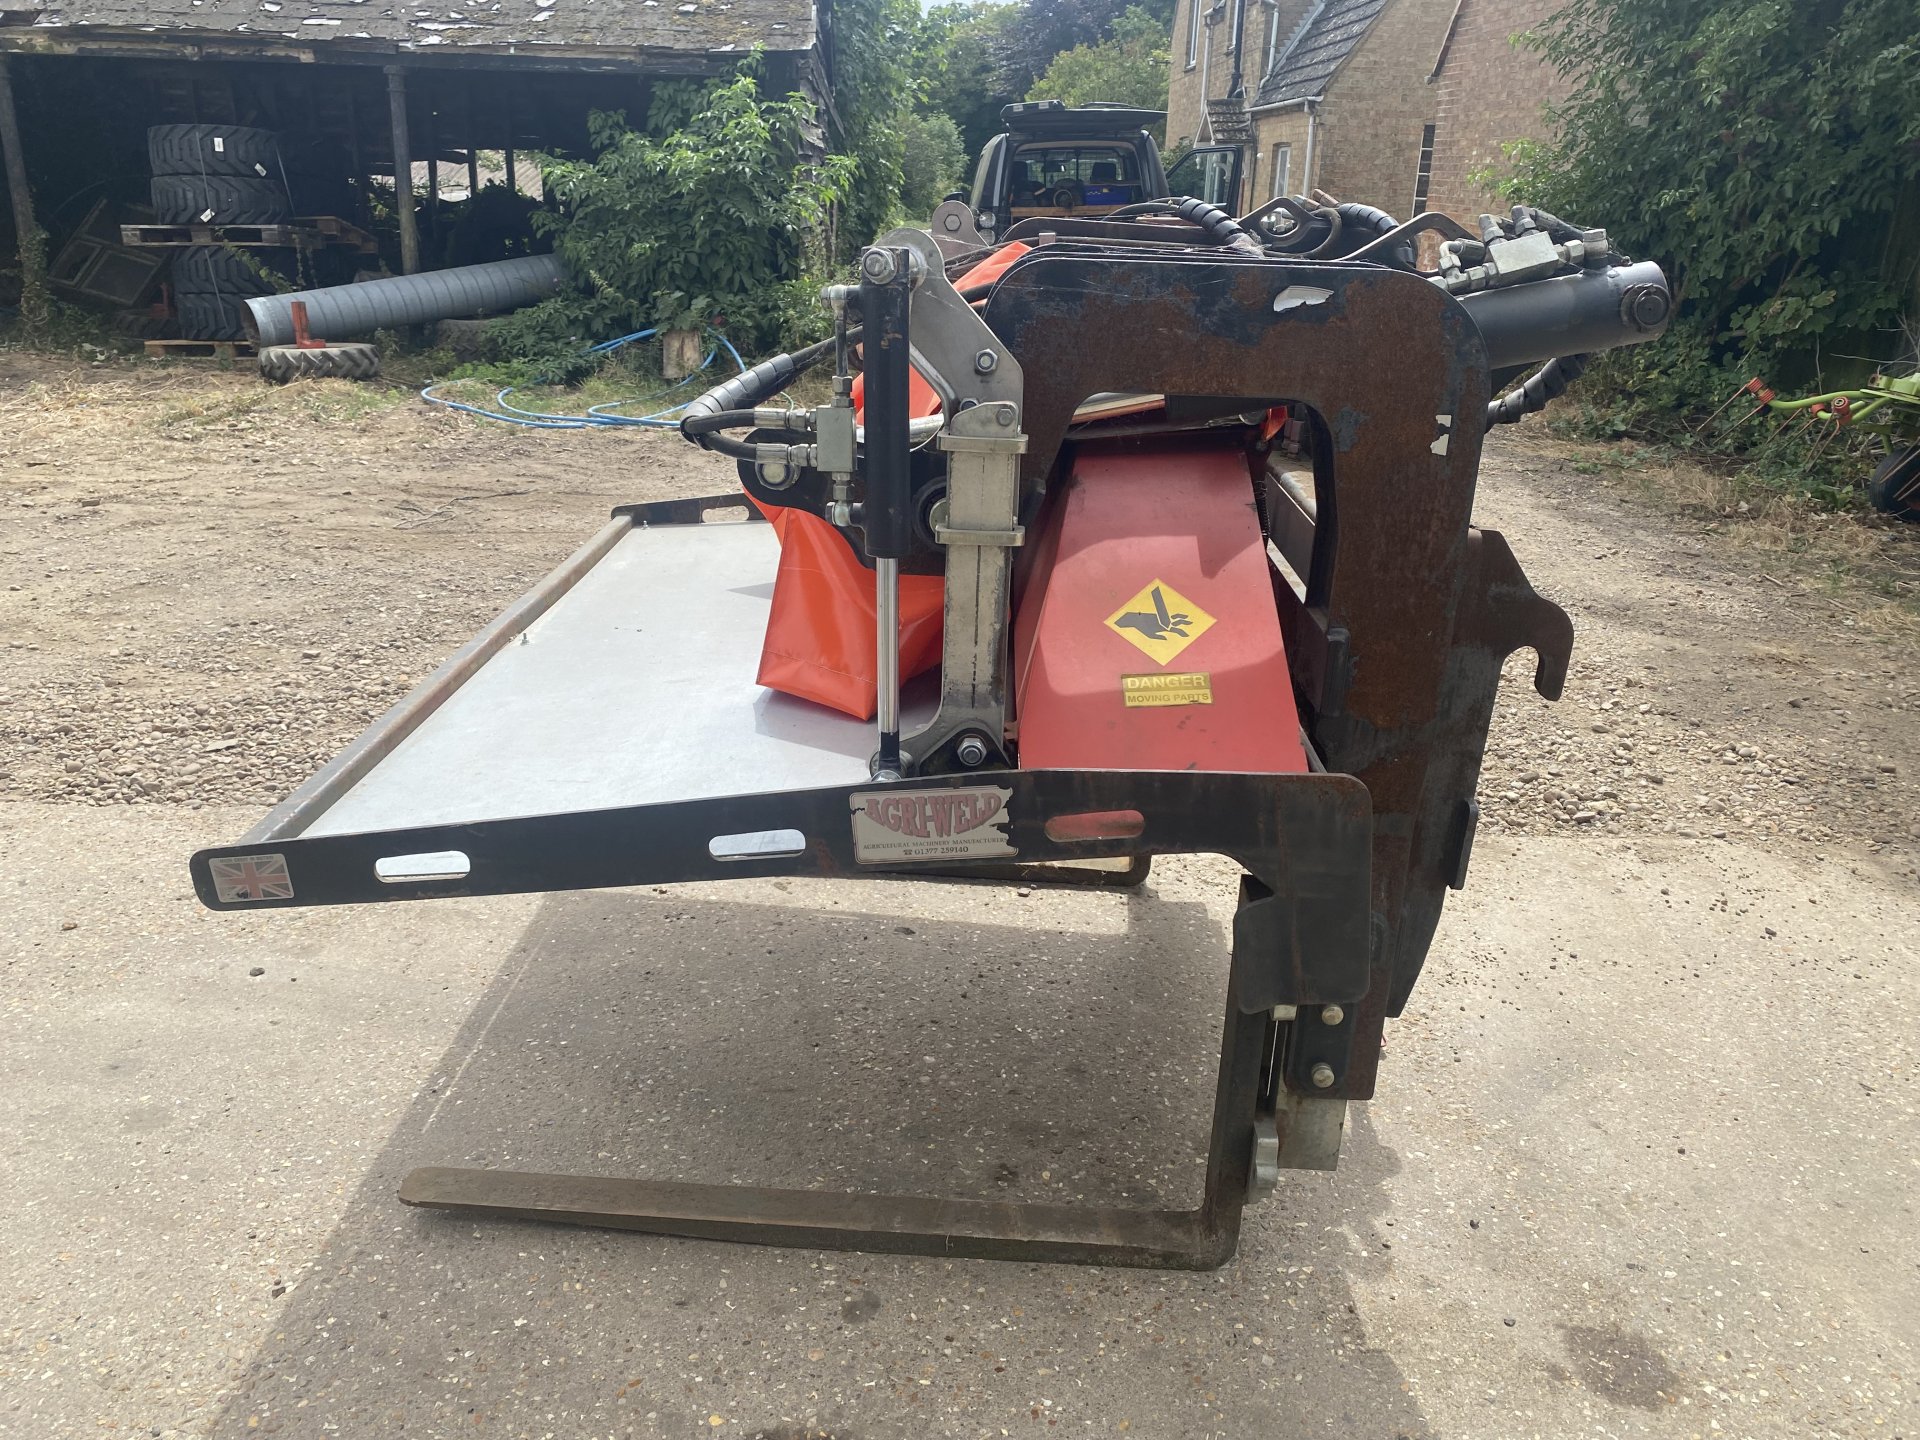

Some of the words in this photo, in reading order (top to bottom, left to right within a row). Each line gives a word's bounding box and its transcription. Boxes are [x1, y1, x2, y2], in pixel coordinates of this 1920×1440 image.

[1127, 676, 1205, 689] DANGER
[1127, 694, 1170, 703] MOVING
[1173, 693, 1209, 702] PARTS
[864, 793, 1002, 838] AGRI-WELD
[863, 842, 910, 850] AGRICULTURAL
[952, 837, 1008, 845] MANUFACTURERS
[914, 847, 938, 855] 01377
[941, 846, 969, 854] 259140
